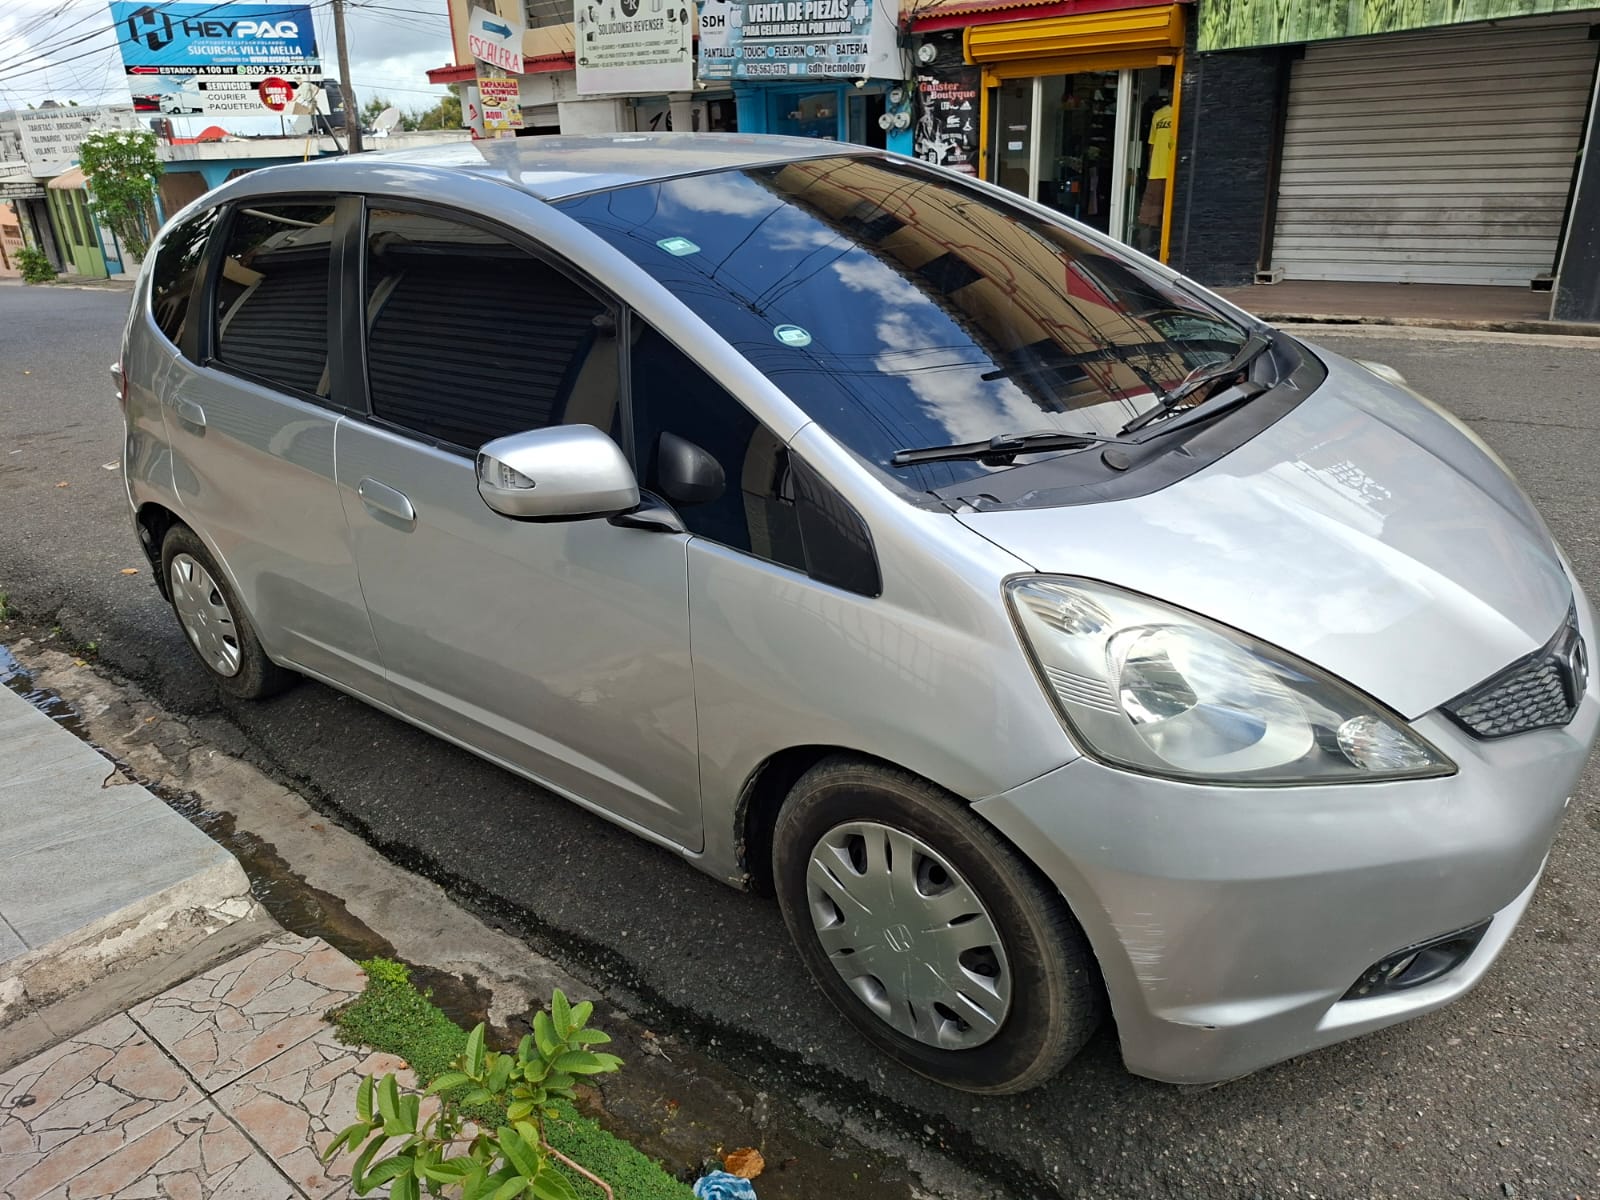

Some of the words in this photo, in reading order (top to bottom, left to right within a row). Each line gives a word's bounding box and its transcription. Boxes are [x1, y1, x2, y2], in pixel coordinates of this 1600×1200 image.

[748, 4, 785, 22] VENTA
[787, 3, 803, 21] DE
[805, 0, 848, 20] PIEZAS
[598, 22, 632, 35] SOLUCIONES
[634, 18, 664, 32] REVENSER
[702, 15, 725, 27] SDH
[183, 21, 298, 38] HEYPAQ
[742, 25, 760, 36] PARA
[761, 24, 798, 35] CELULARES
[799, 23, 808, 34] AL
[809, 22, 823, 33] POR
[825, 21, 852, 33] MAYOR
[187, 46, 239, 55] SUCURSAL
[241, 46, 268, 55] VILLA
[270, 46, 302, 55] MELLA
[469, 34, 520, 71] ESCALERA
[704, 47, 735, 58] PANTALLA
[743, 46, 766, 57] TOUCH
[814, 45, 827, 56] PIN
[836, 43, 868, 55] BATERIA
[247, 66, 315, 75] 809.539.6417
[808, 63, 822, 73] sdh
[824, 63, 866, 74] tecnology
[206, 82, 251, 90] SERVICIOS
[485, 111, 503, 119] AQUI
[34, 147, 57, 155] VOLANTE
